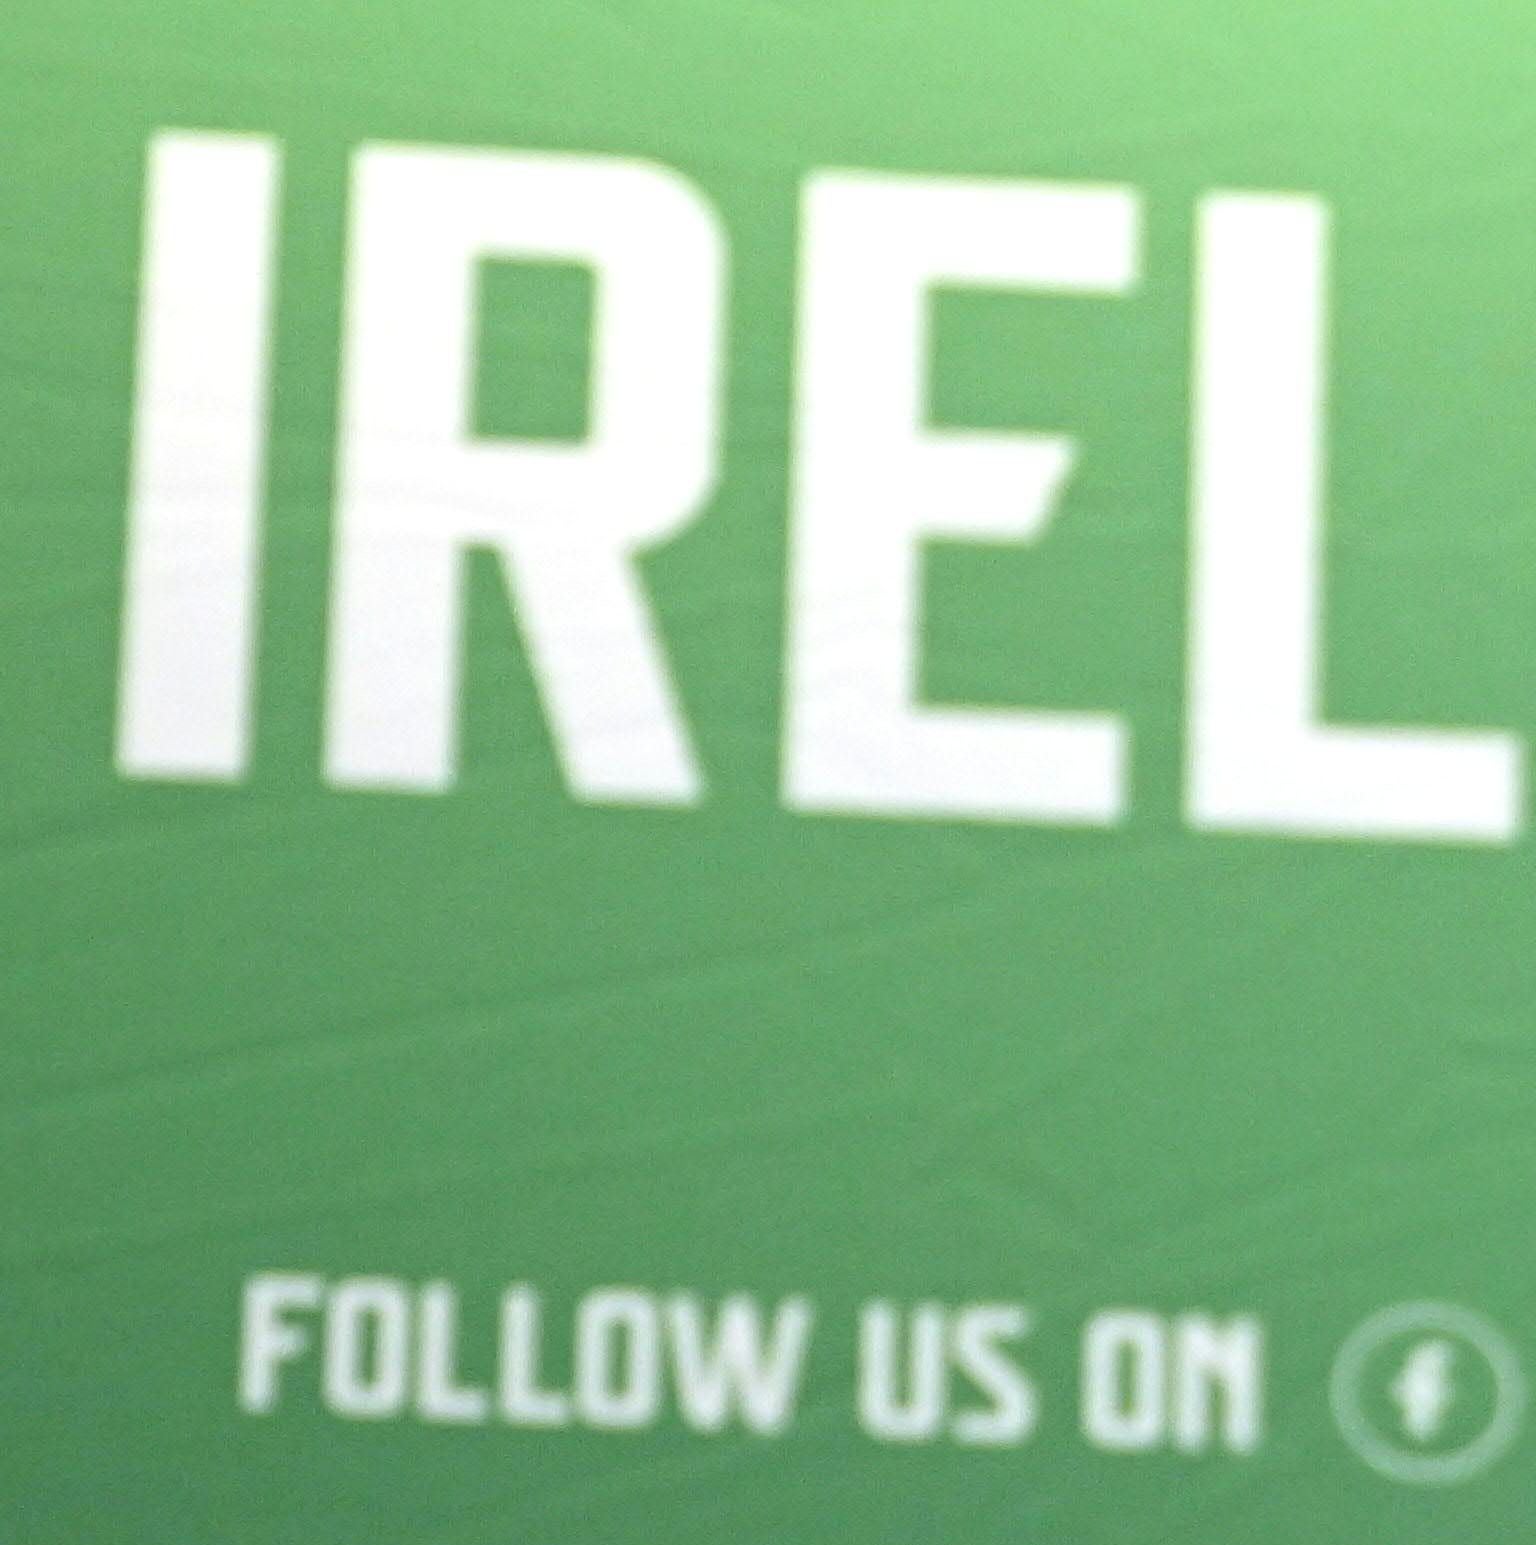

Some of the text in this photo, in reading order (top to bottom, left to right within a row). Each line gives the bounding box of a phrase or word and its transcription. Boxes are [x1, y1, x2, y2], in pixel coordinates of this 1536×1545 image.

[238, 1270, 807, 1439] FOLLOW
[857, 1295, 1040, 1453] US
[1081, 1306, 1268, 1460] ON
